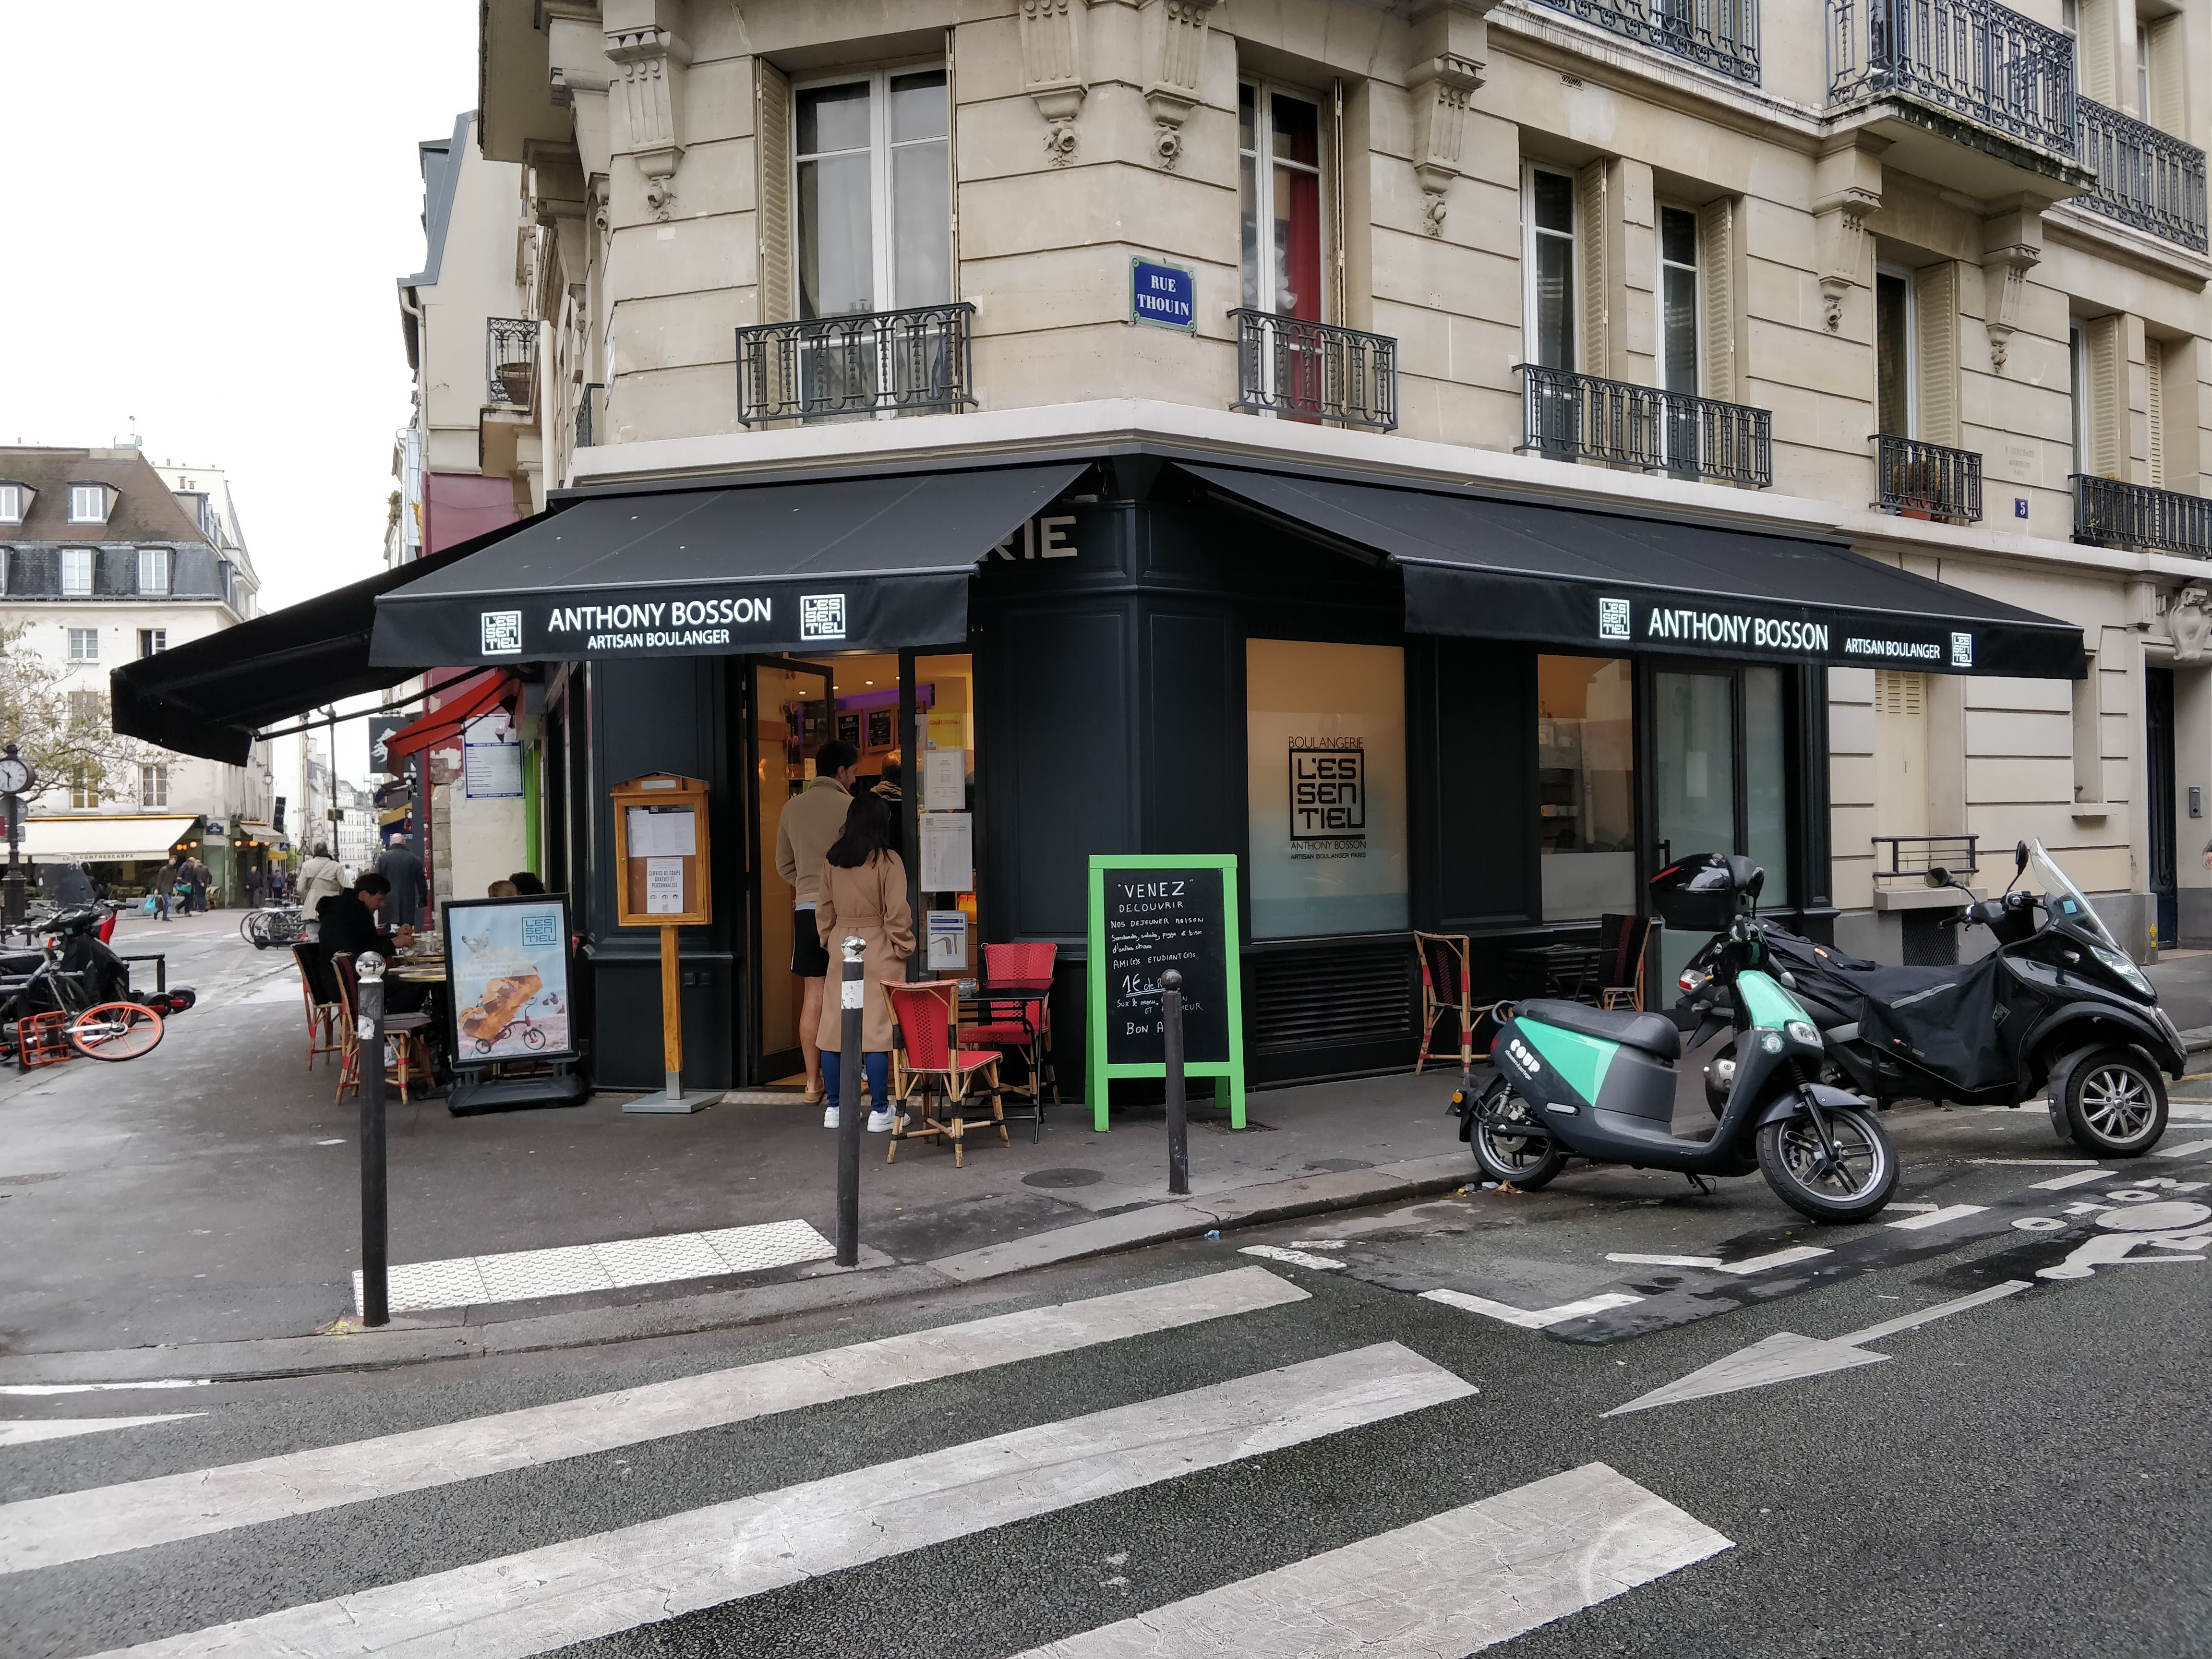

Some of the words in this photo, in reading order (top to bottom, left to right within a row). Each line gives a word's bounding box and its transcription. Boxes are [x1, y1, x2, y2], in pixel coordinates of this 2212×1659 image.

[1150, 274, 1176, 293] RUE
[1137, 293, 1190, 316] THOUIN
[2020, 502, 2026, 516] 5
[548, 602, 666, 632] ANTHONY
[672, 598, 772, 625] BOSSON
[587, 633, 644, 649] ARTISAN
[646, 629, 730, 647] BOULANGER
[1648, 608, 1751, 643] ANTHONY
[1755, 618, 1828, 651] BOSSON
[1845, 638, 1885, 655] ARTISAN
[1887, 641, 1940, 659] BOULANGER
[1288, 736, 1364, 749] BOULANGERIE
[1291, 842, 1332, 850] ANTHONY
[1334, 840, 1366, 850] BOSSON
[1119, 901, 1184, 913] DECOUVRIR
[1111, 920, 1125, 929] NOS
[1130, 918, 1169, 927] DEJEUNER
[1122, 974, 1141, 993] 1€
[1143, 977, 1155, 991] de
[1510, 1039, 1540, 1072] COUP
